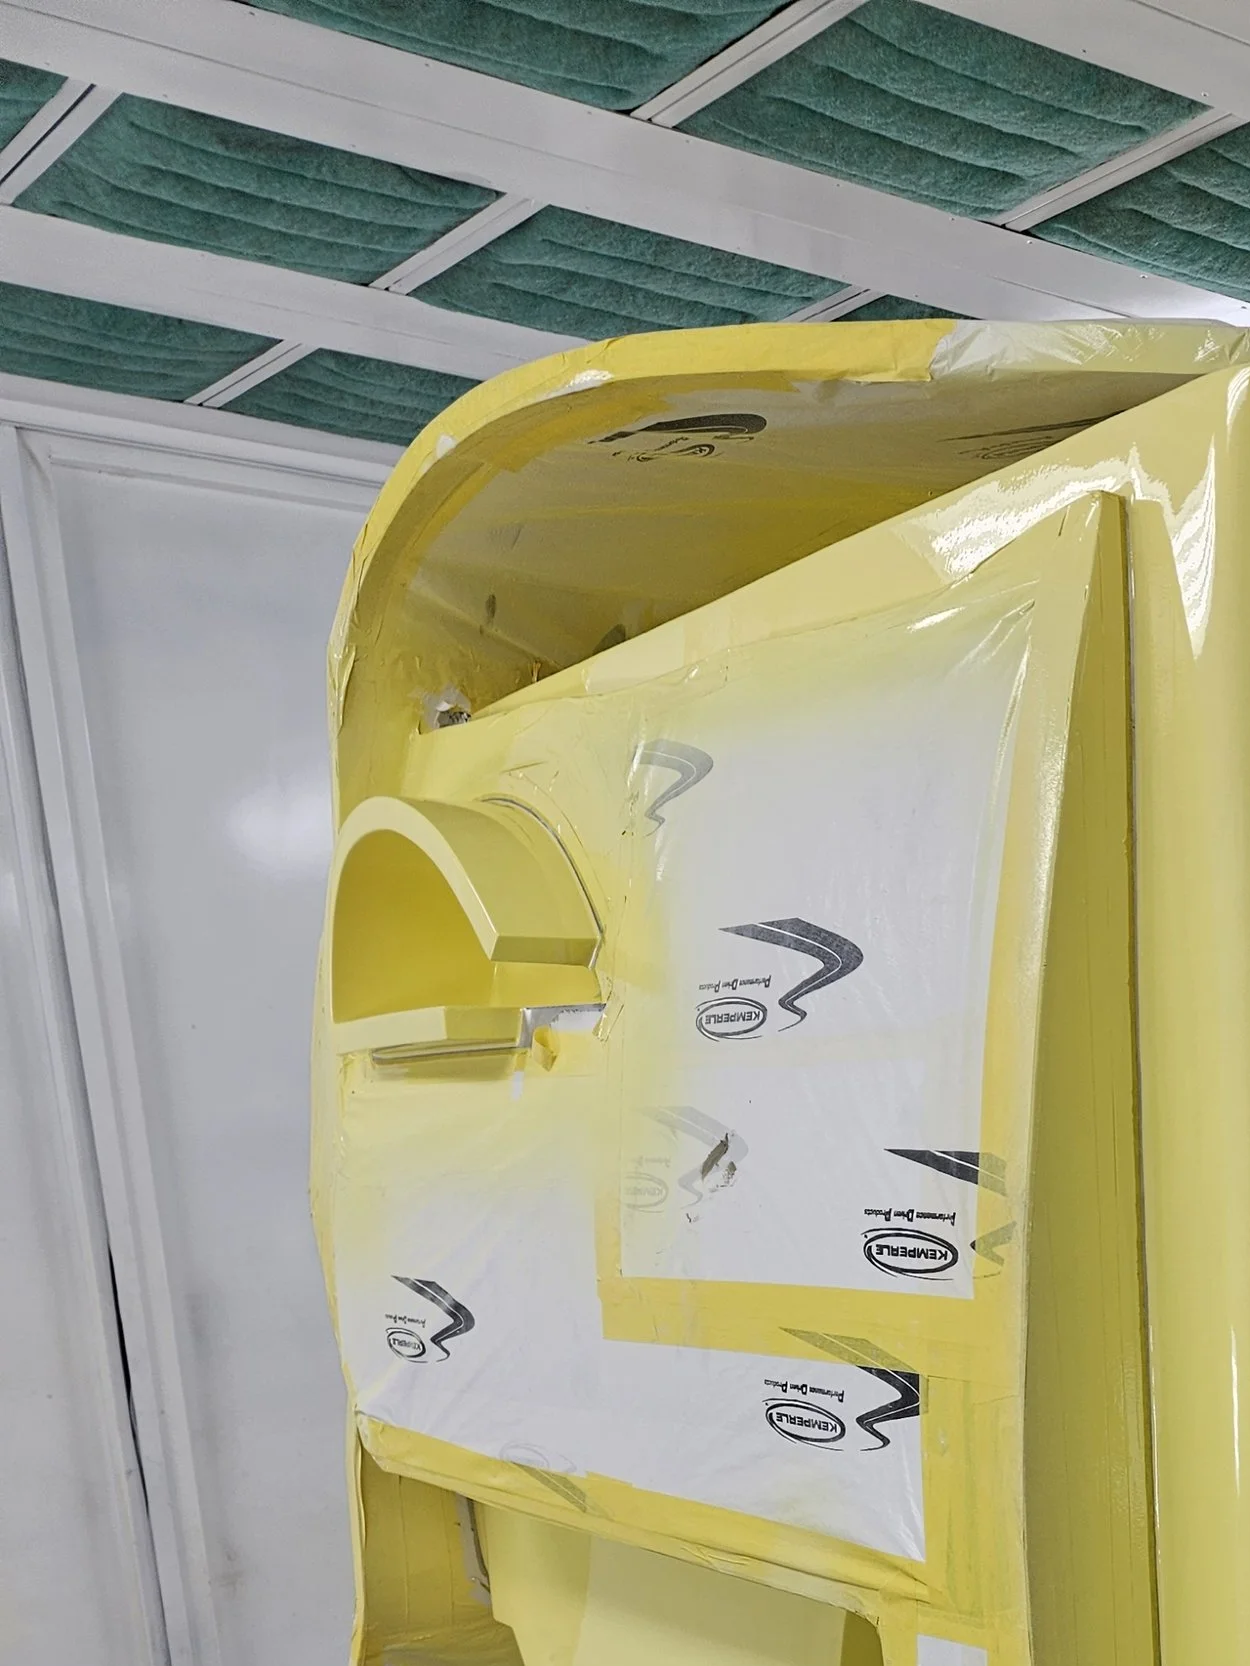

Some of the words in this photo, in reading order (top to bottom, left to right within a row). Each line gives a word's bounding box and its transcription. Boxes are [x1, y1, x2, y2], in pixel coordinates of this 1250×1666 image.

[704, 1010, 761, 1025] KEMPERLE
[875, 1243, 948, 1261] KEMPERLE
[775, 1411, 838, 1433] KEMPERLE
